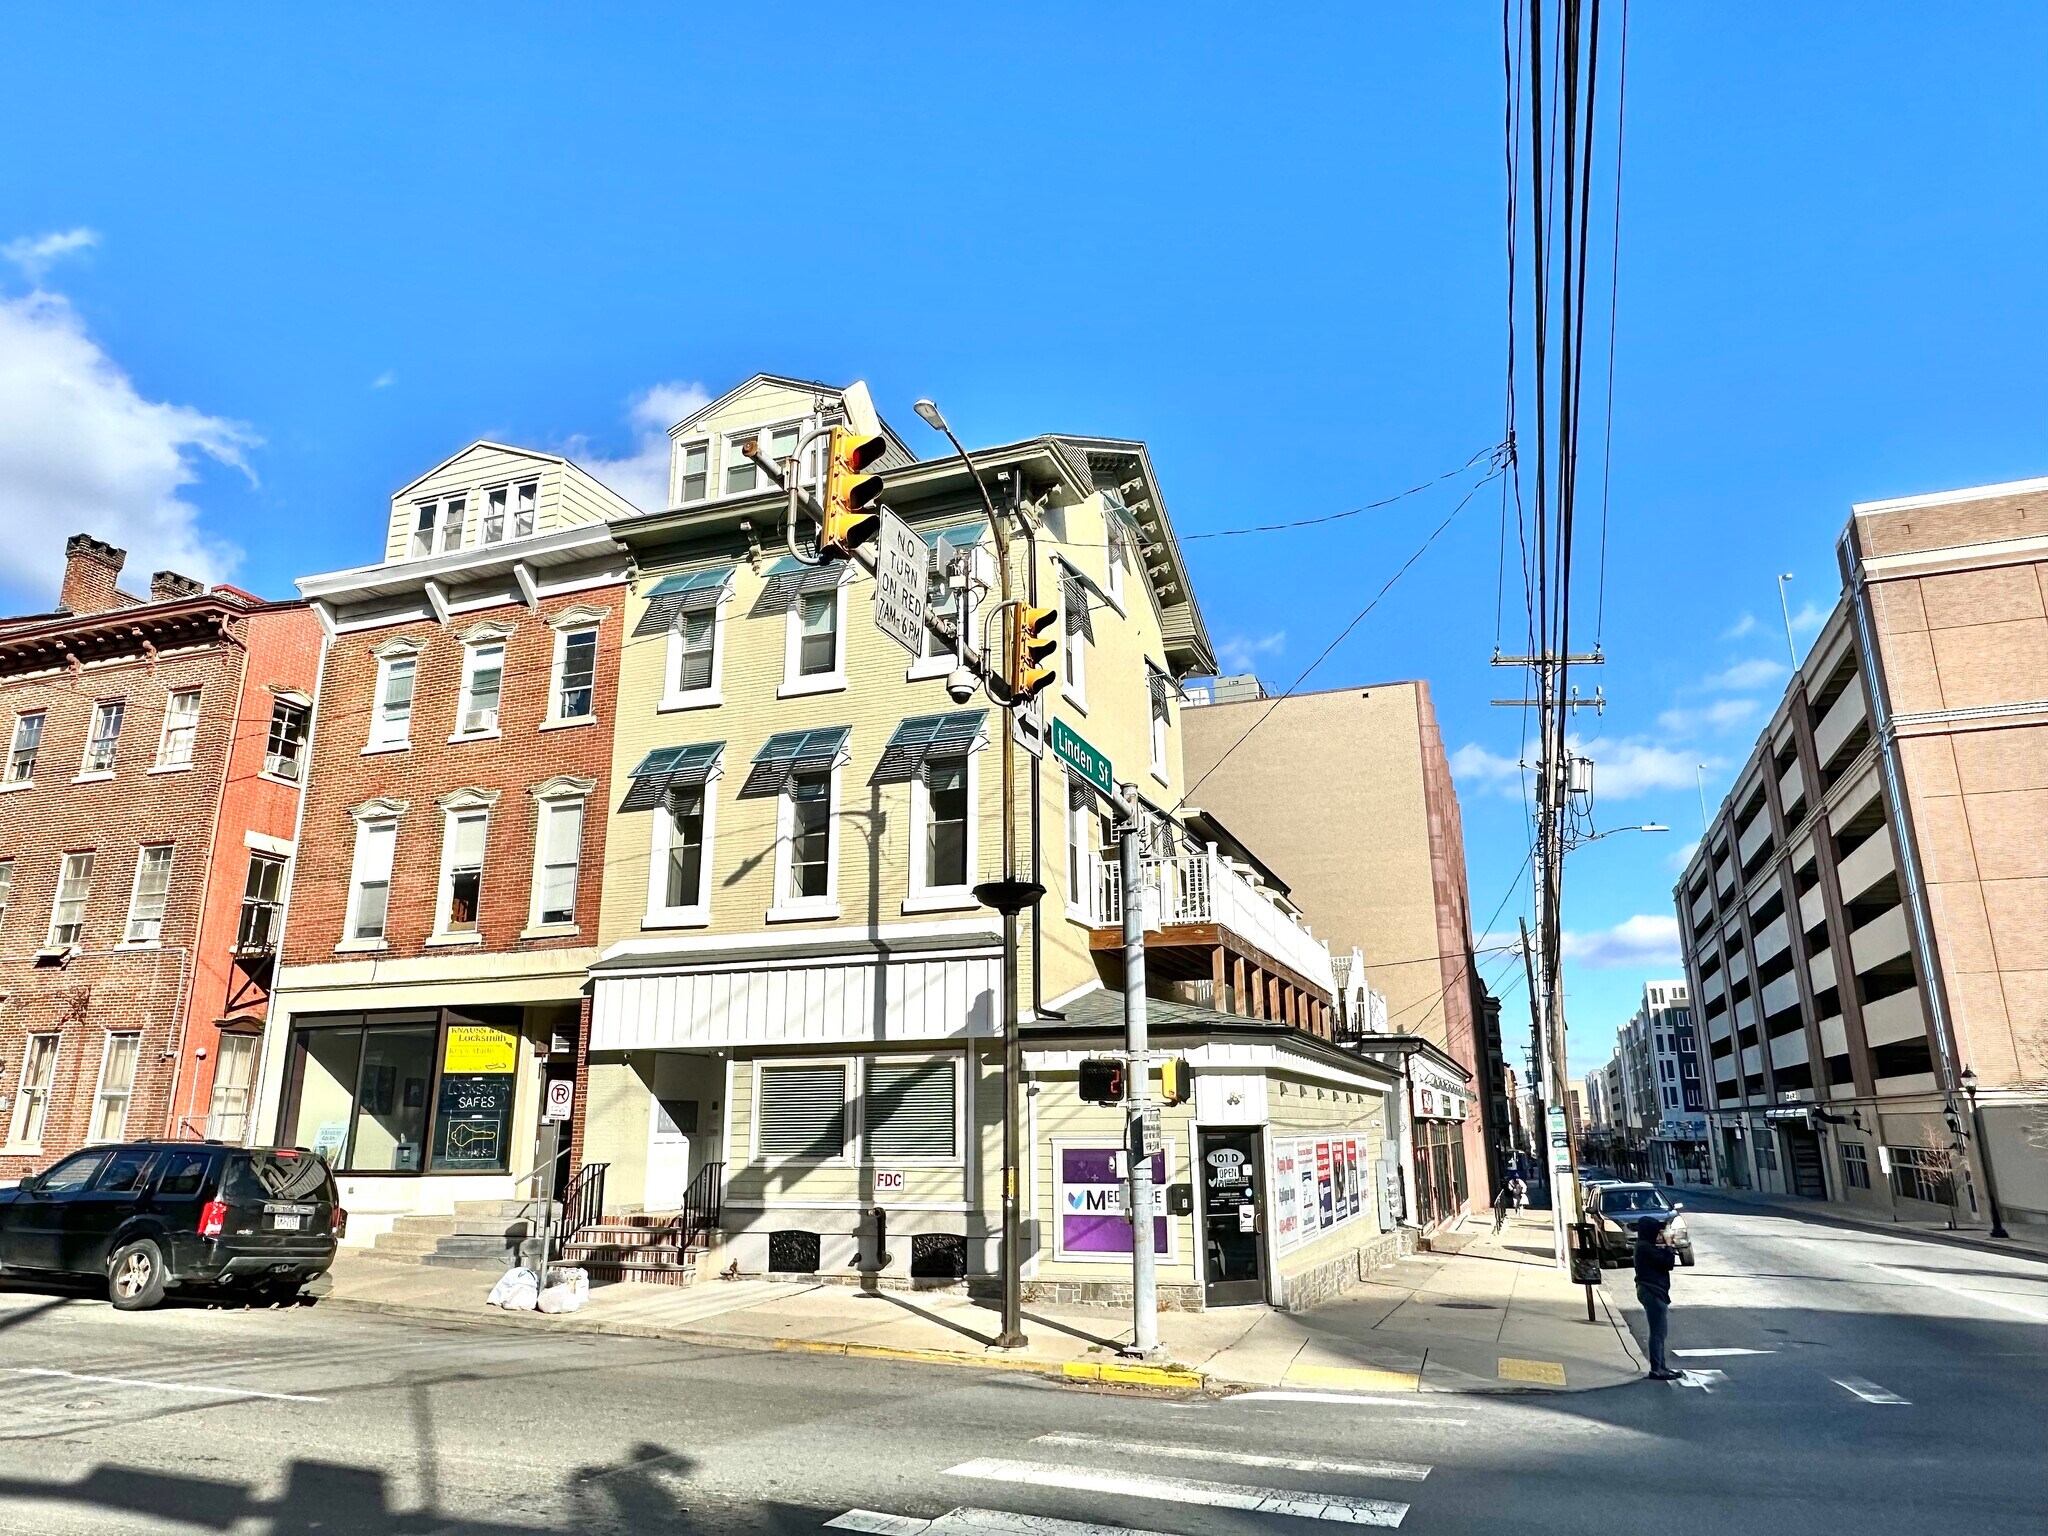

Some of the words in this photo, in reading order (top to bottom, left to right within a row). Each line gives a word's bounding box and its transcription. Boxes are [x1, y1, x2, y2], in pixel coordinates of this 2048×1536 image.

[897, 530, 915, 558] NO
[890, 550, 918, 589] TURN
[882, 573, 897, 599] ON
[901, 587, 921, 617] RED
[1058, 727, 1093, 773] Linden
[1098, 760, 1109, 786] St
[458, 1096, 496, 1108] SAFES
[1213, 1153, 1228, 1163] 101
[1231, 1153, 1239, 1163] D
[877, 1173, 902, 1187] FDC
[1219, 1168, 1238, 1179] OPEN
